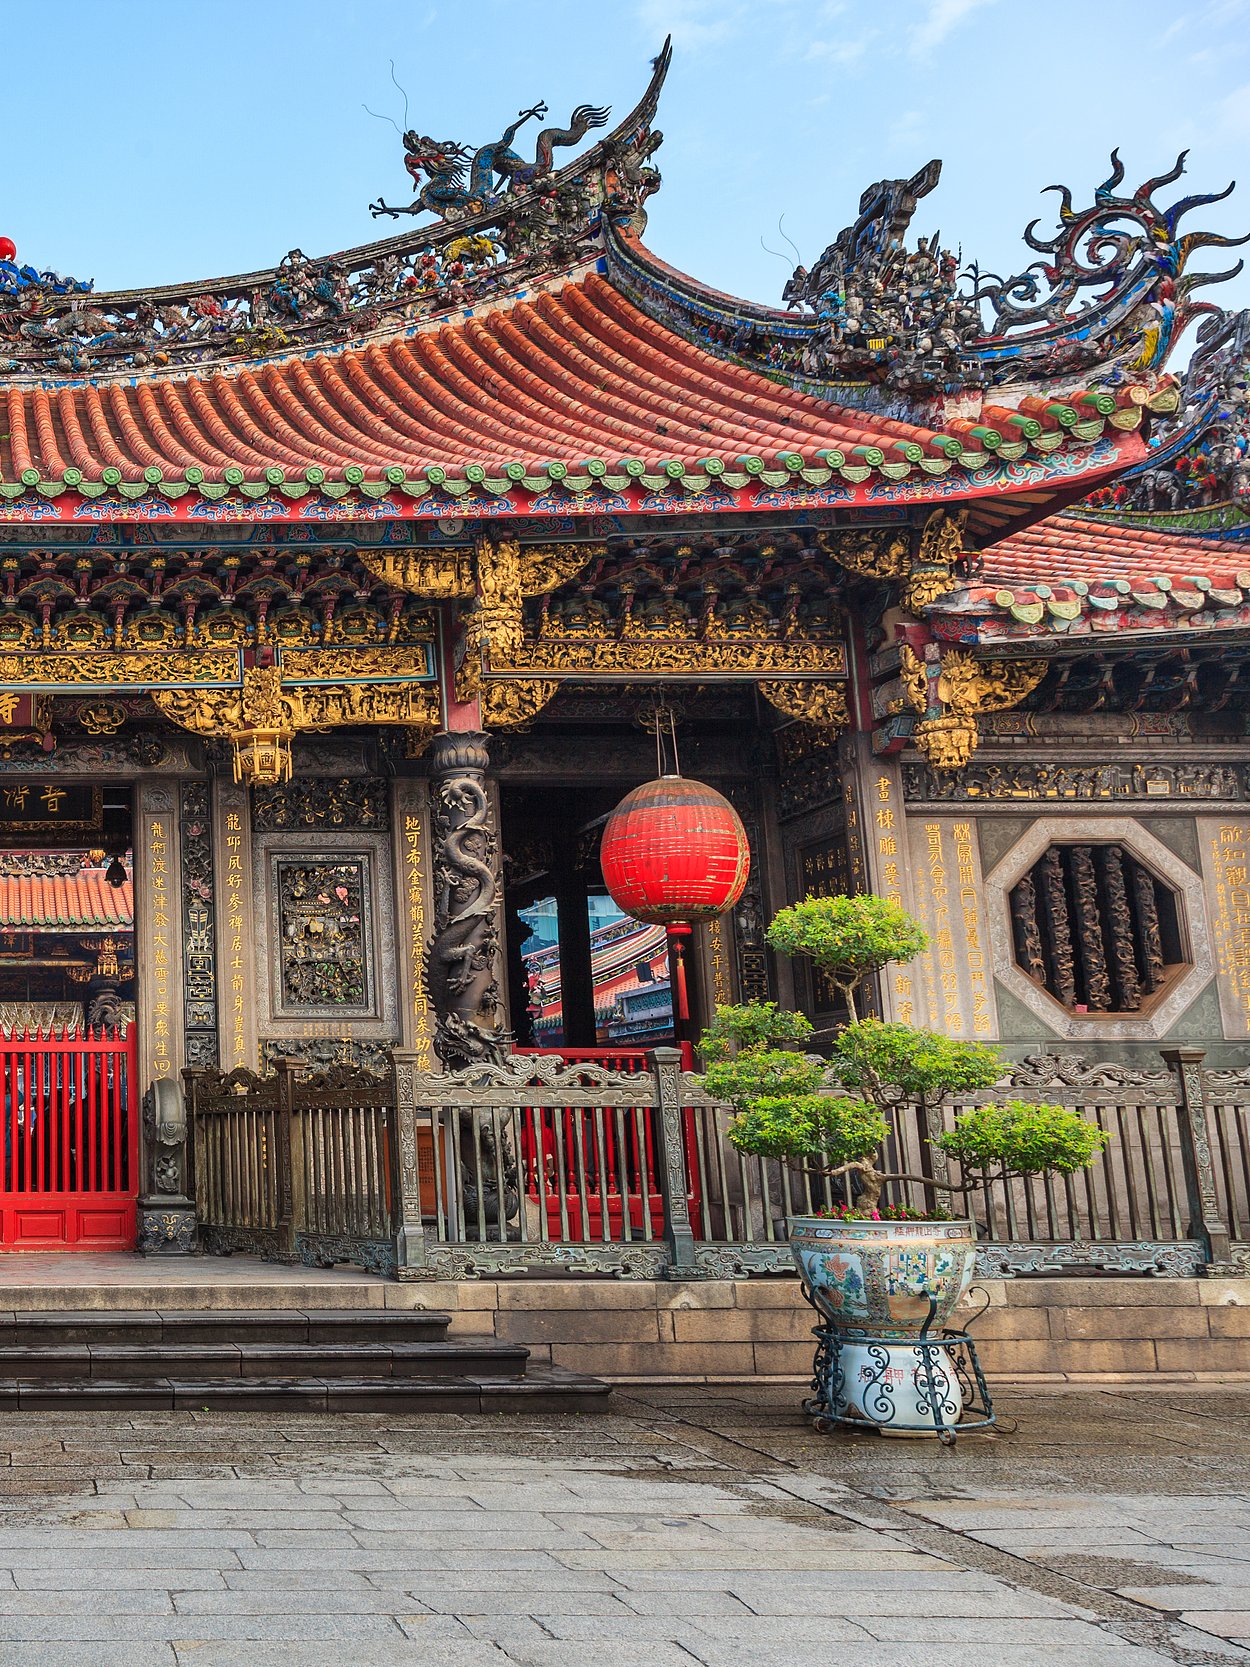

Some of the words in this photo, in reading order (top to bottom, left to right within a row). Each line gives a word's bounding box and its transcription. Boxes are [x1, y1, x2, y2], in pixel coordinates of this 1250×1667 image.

[874, 777, 915, 1024] 畫棟雕甍廟新資
